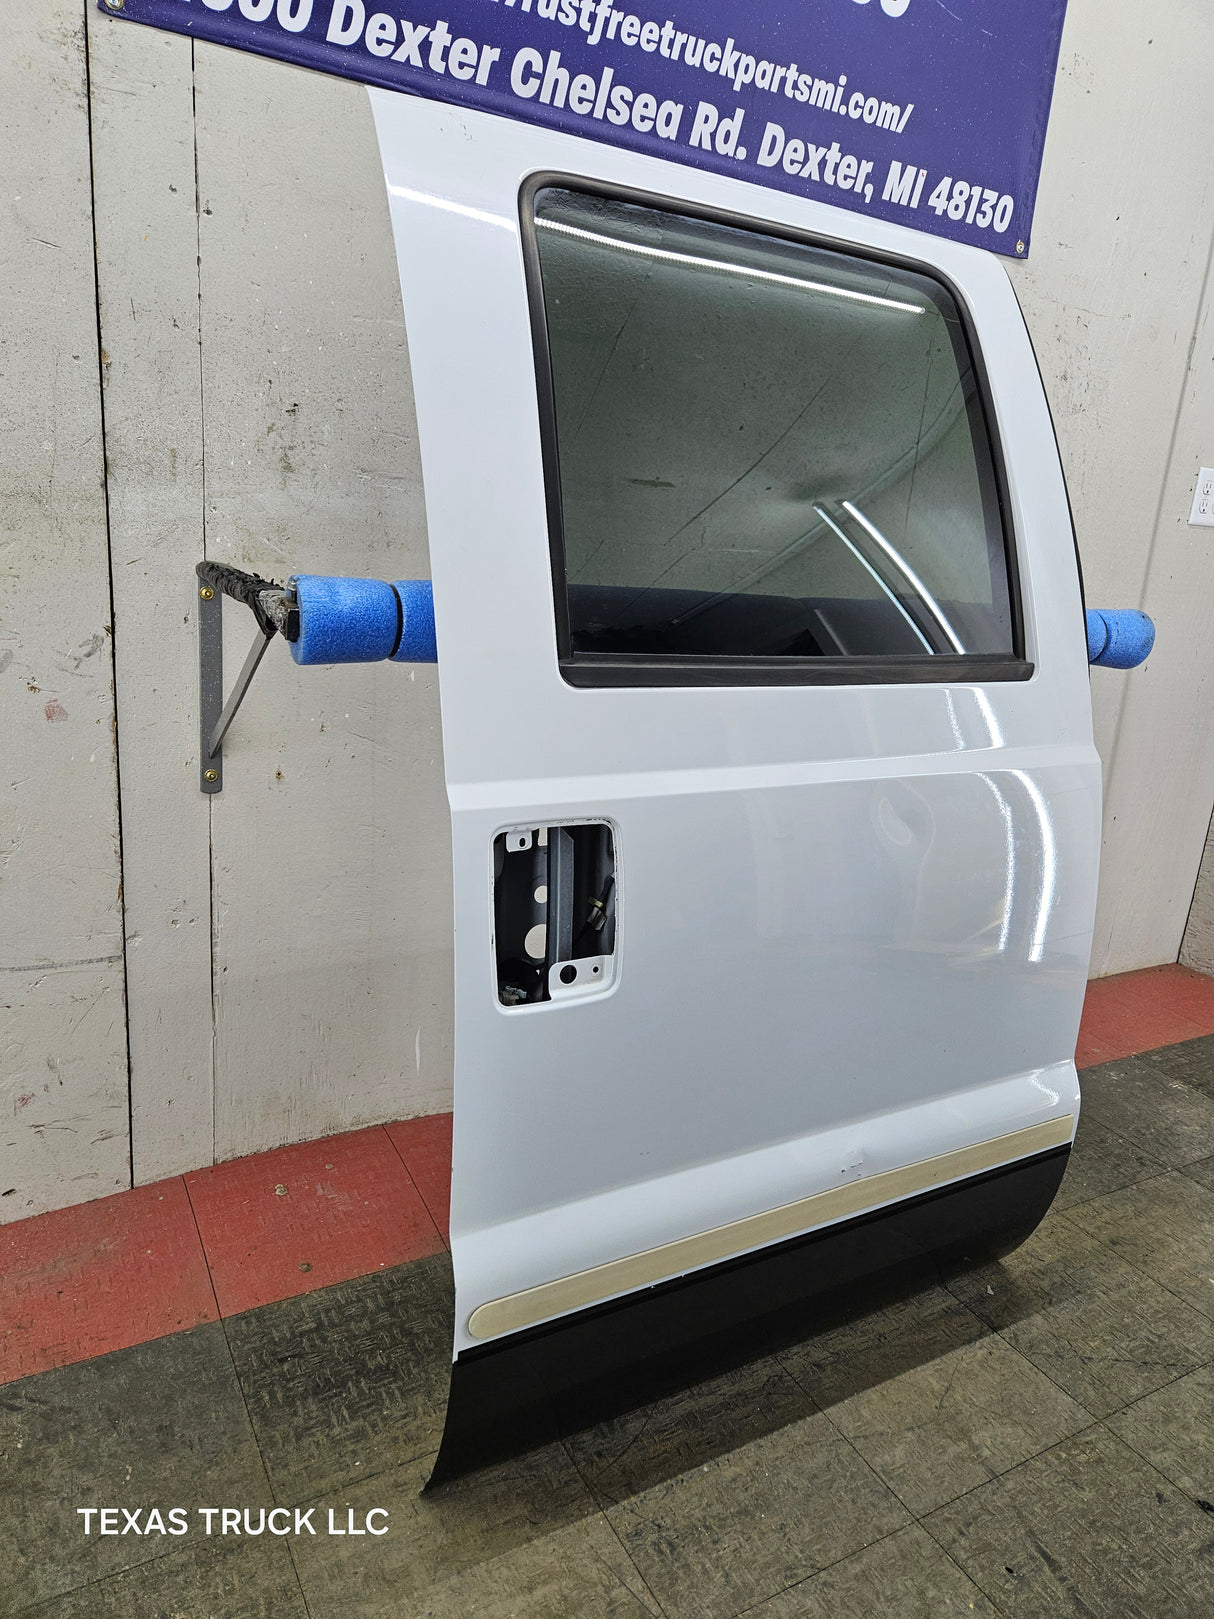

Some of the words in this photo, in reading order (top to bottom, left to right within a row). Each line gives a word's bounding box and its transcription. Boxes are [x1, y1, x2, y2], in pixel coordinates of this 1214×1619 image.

[326, 0, 501, 86] Dexter
[511, 47, 683, 141] Chelsea
[689, 101, 747, 161] Rd.
[757, 122, 873, 204] Dexter,
[882, 160, 927, 209] MI
[928, 176, 1014, 233] 48130
